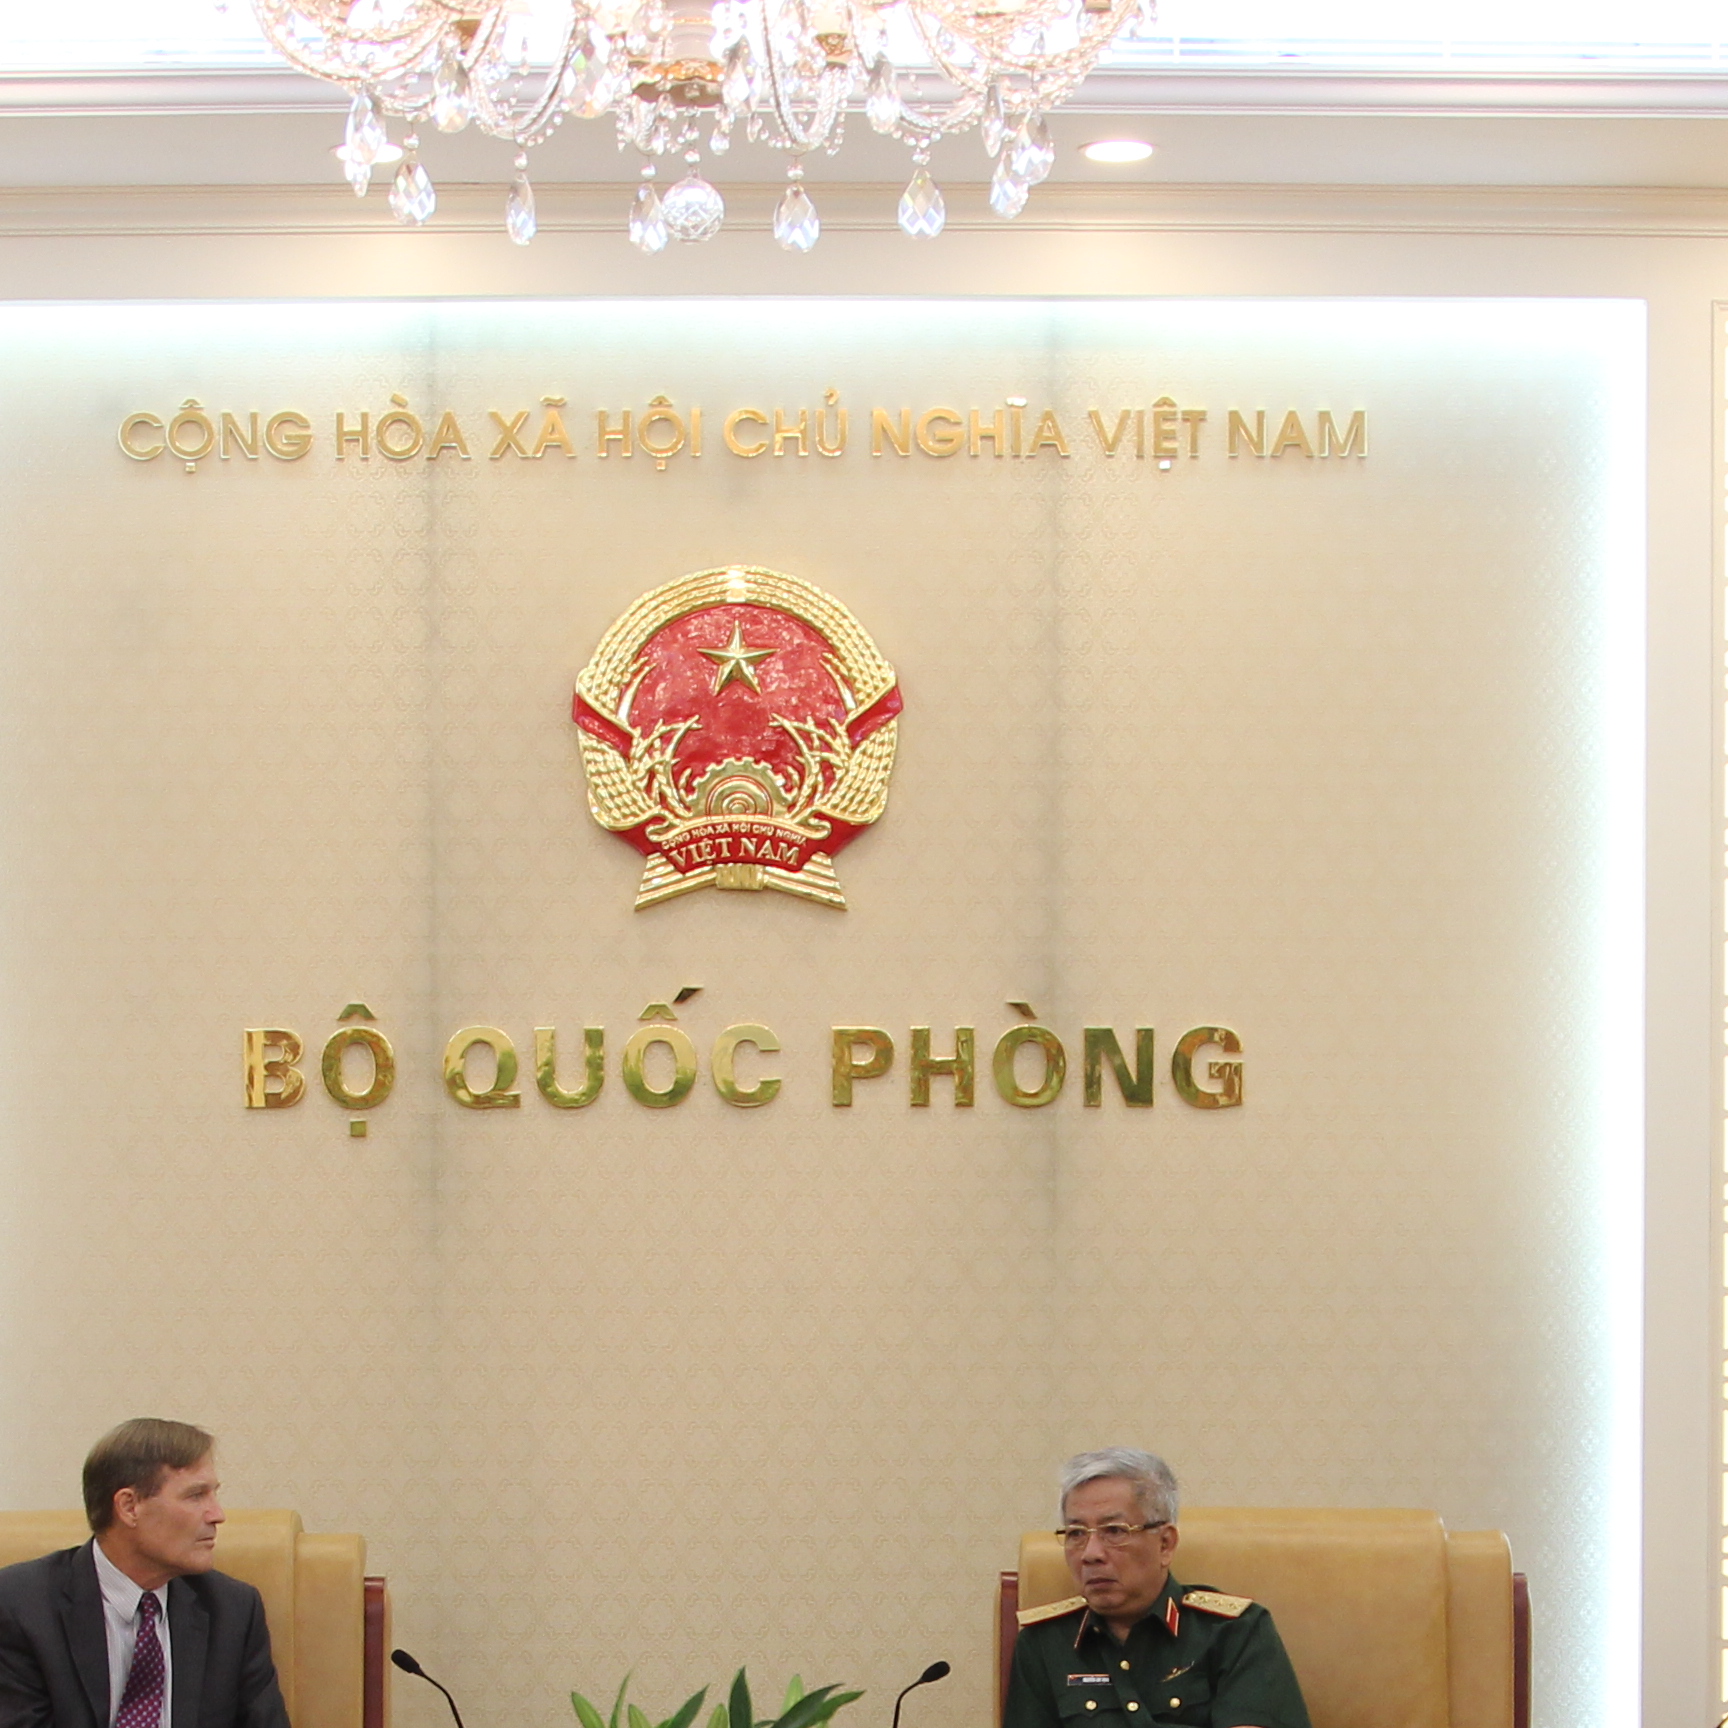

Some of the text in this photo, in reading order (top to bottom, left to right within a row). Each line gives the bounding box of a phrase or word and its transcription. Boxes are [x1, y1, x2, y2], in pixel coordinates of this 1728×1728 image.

[118, 387, 1369, 474] CỘNG HÒA XÃ HỘI CHỦ NGHĨA VIỆT NAM
[668, 837, 800, 868] VIỆT NAM
[242, 986, 1246, 1138] BỘ QUỐC PHÒNG
